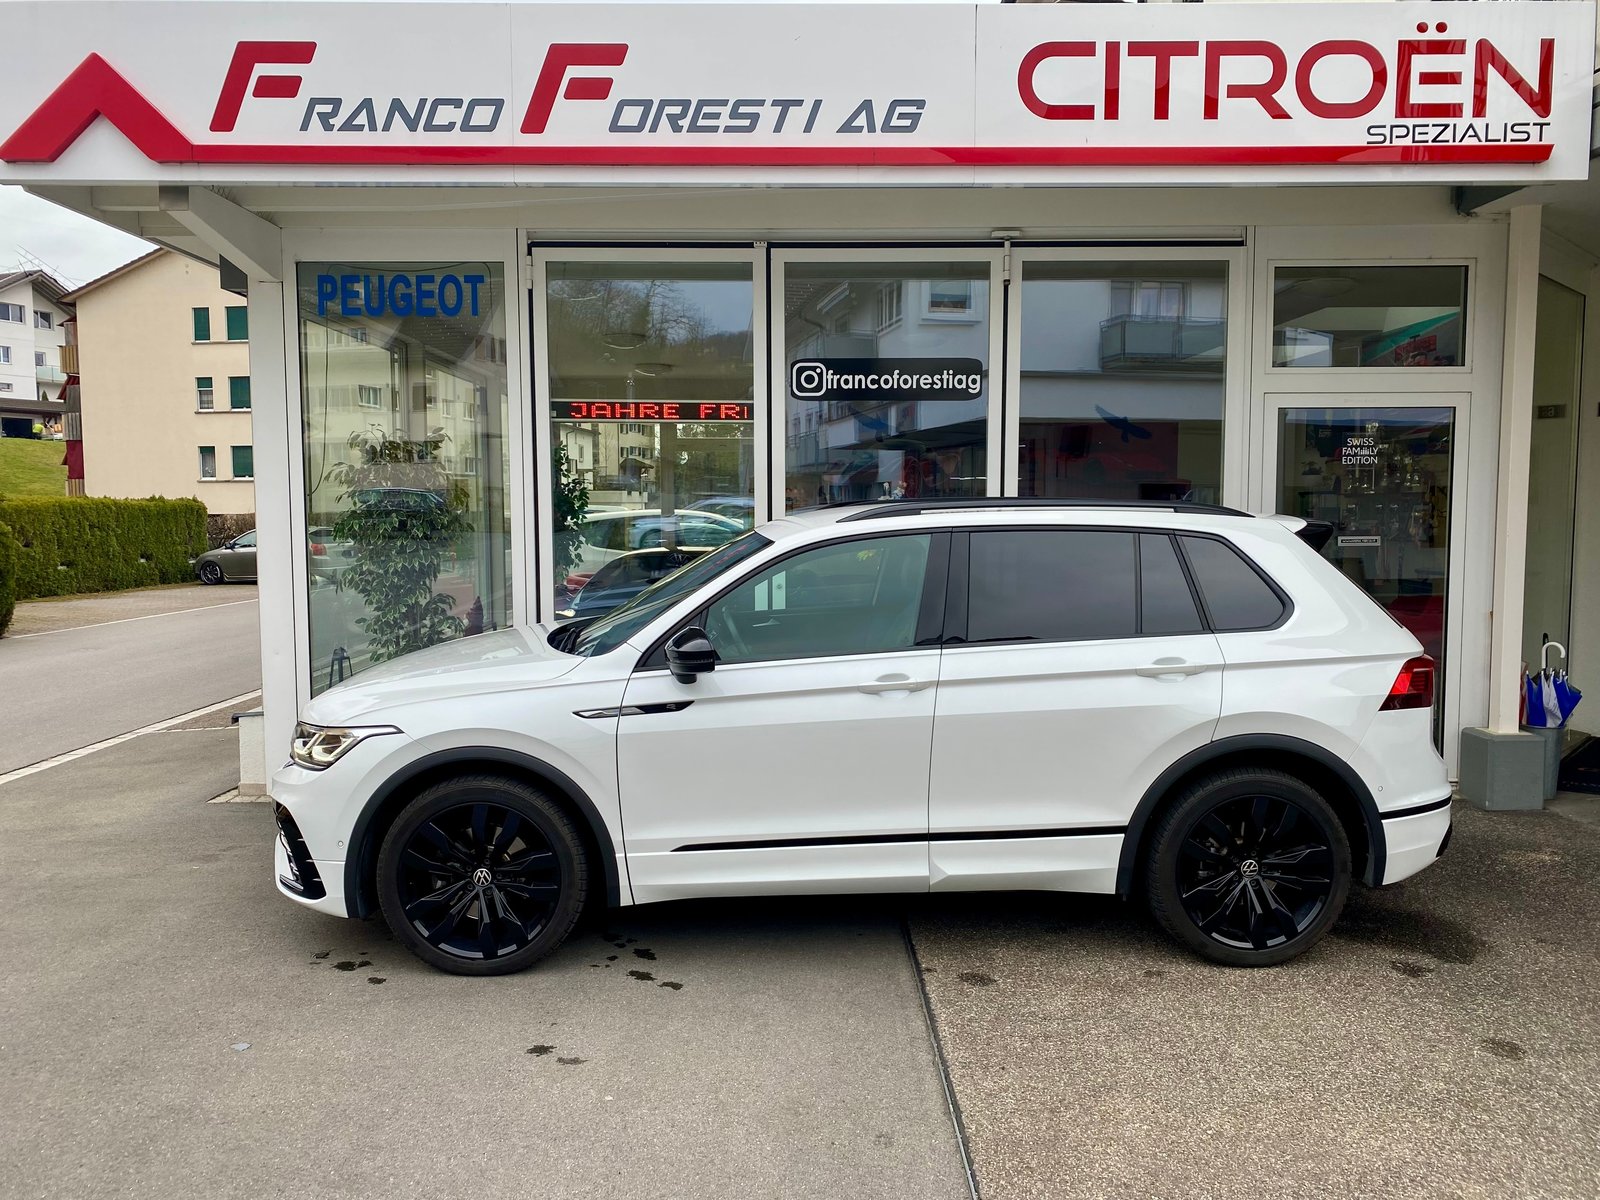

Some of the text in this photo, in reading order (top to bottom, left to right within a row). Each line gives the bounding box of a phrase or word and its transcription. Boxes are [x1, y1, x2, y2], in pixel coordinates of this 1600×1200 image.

[1016, 21, 1554, 121] CITROËN
[209, 41, 927, 135] FRANCO FORESTI AG
[1366, 122, 1551, 145] SPEZIALIST
[316, 273, 486, 318] PEUGEOT
[826, 369, 982, 394] francoforestiag
[570, 402, 680, 419] JAHRE
[1346, 437, 1374, 446] SWISS
[1342, 456, 1378, 465] EDITION
